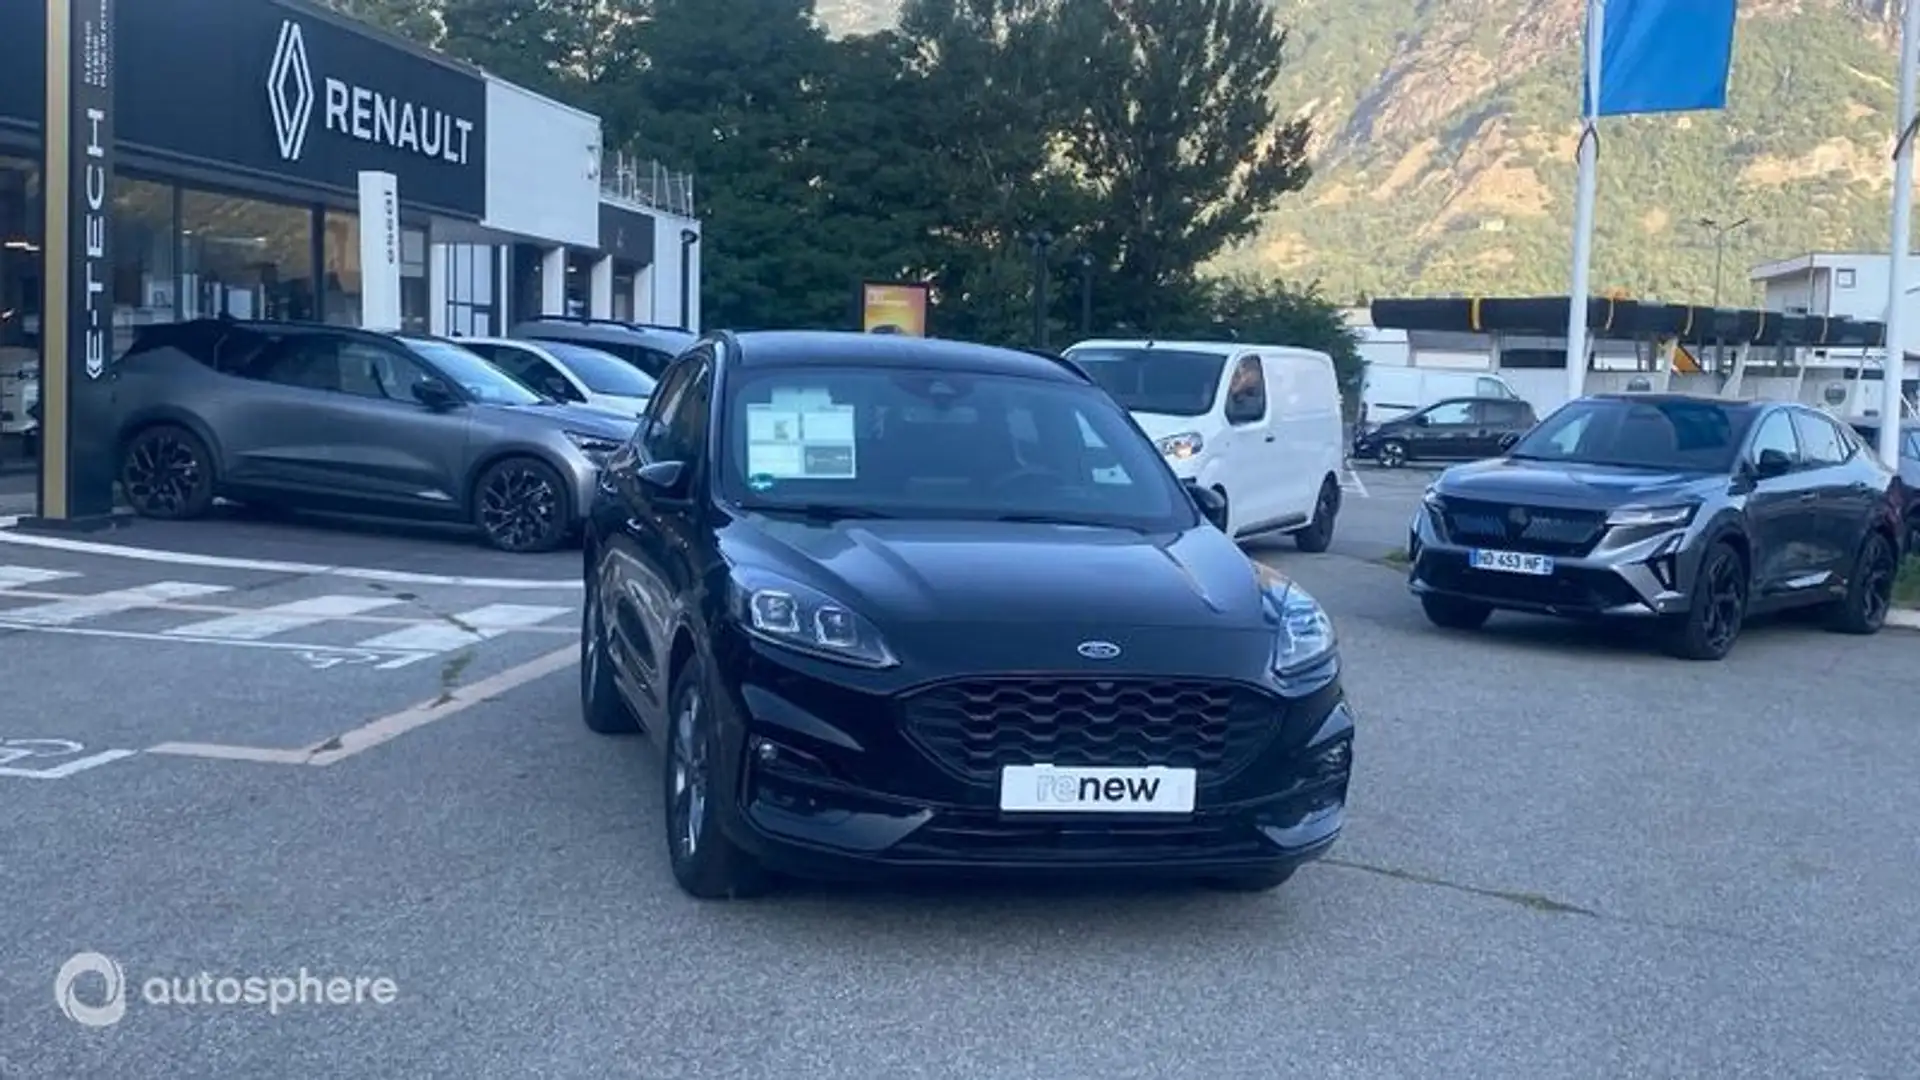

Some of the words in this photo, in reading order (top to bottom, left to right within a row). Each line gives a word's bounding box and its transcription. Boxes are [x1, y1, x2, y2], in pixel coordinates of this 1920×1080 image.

[325, 77, 474, 165] RENAULT
[86, 107, 105, 379] E-TECH
[1036, 774, 1161, 803] renew
